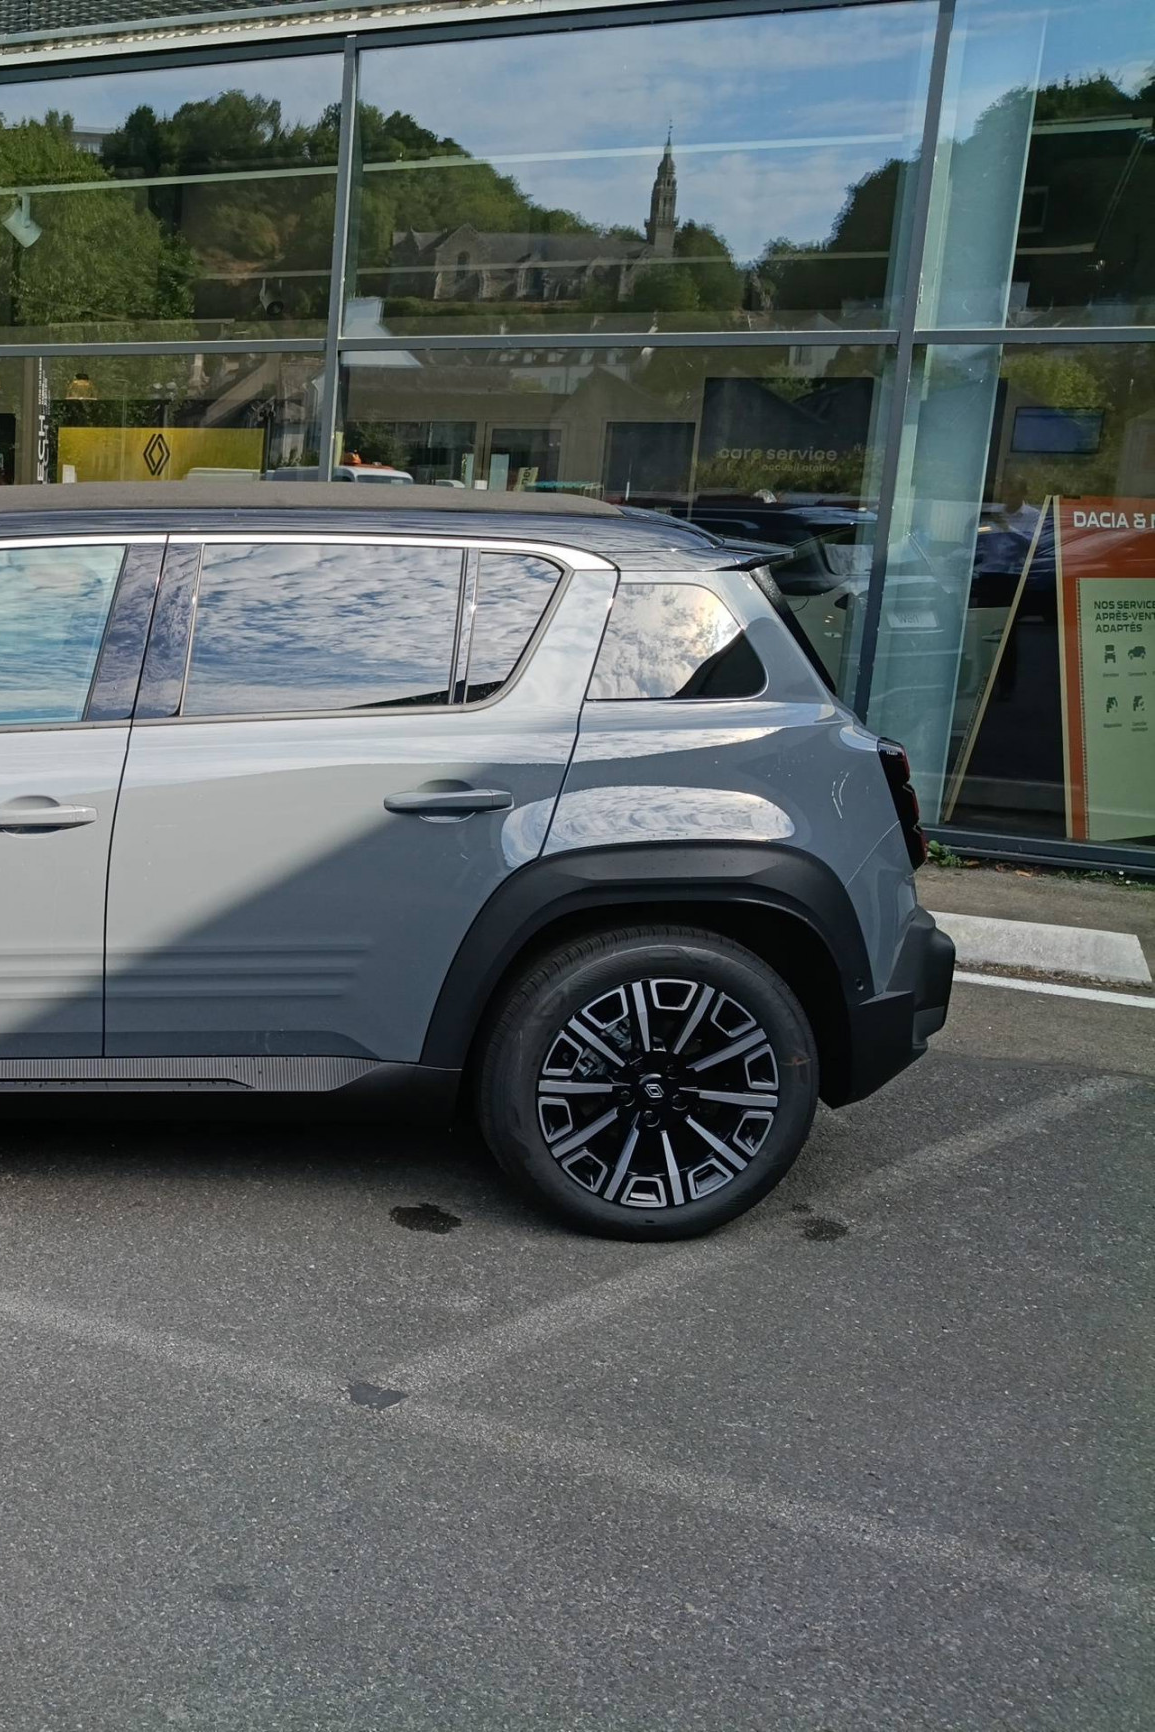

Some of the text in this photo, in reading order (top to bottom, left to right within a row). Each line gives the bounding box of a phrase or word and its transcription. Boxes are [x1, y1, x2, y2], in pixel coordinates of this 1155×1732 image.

[717, 446, 837, 461] care service
[1073, 510, 1130, 529] DACIA
[1133, 512, 1146, 529] &
[1094, 600, 1115, 609] NOS
[1096, 621, 1143, 633] ADAPTÉS
